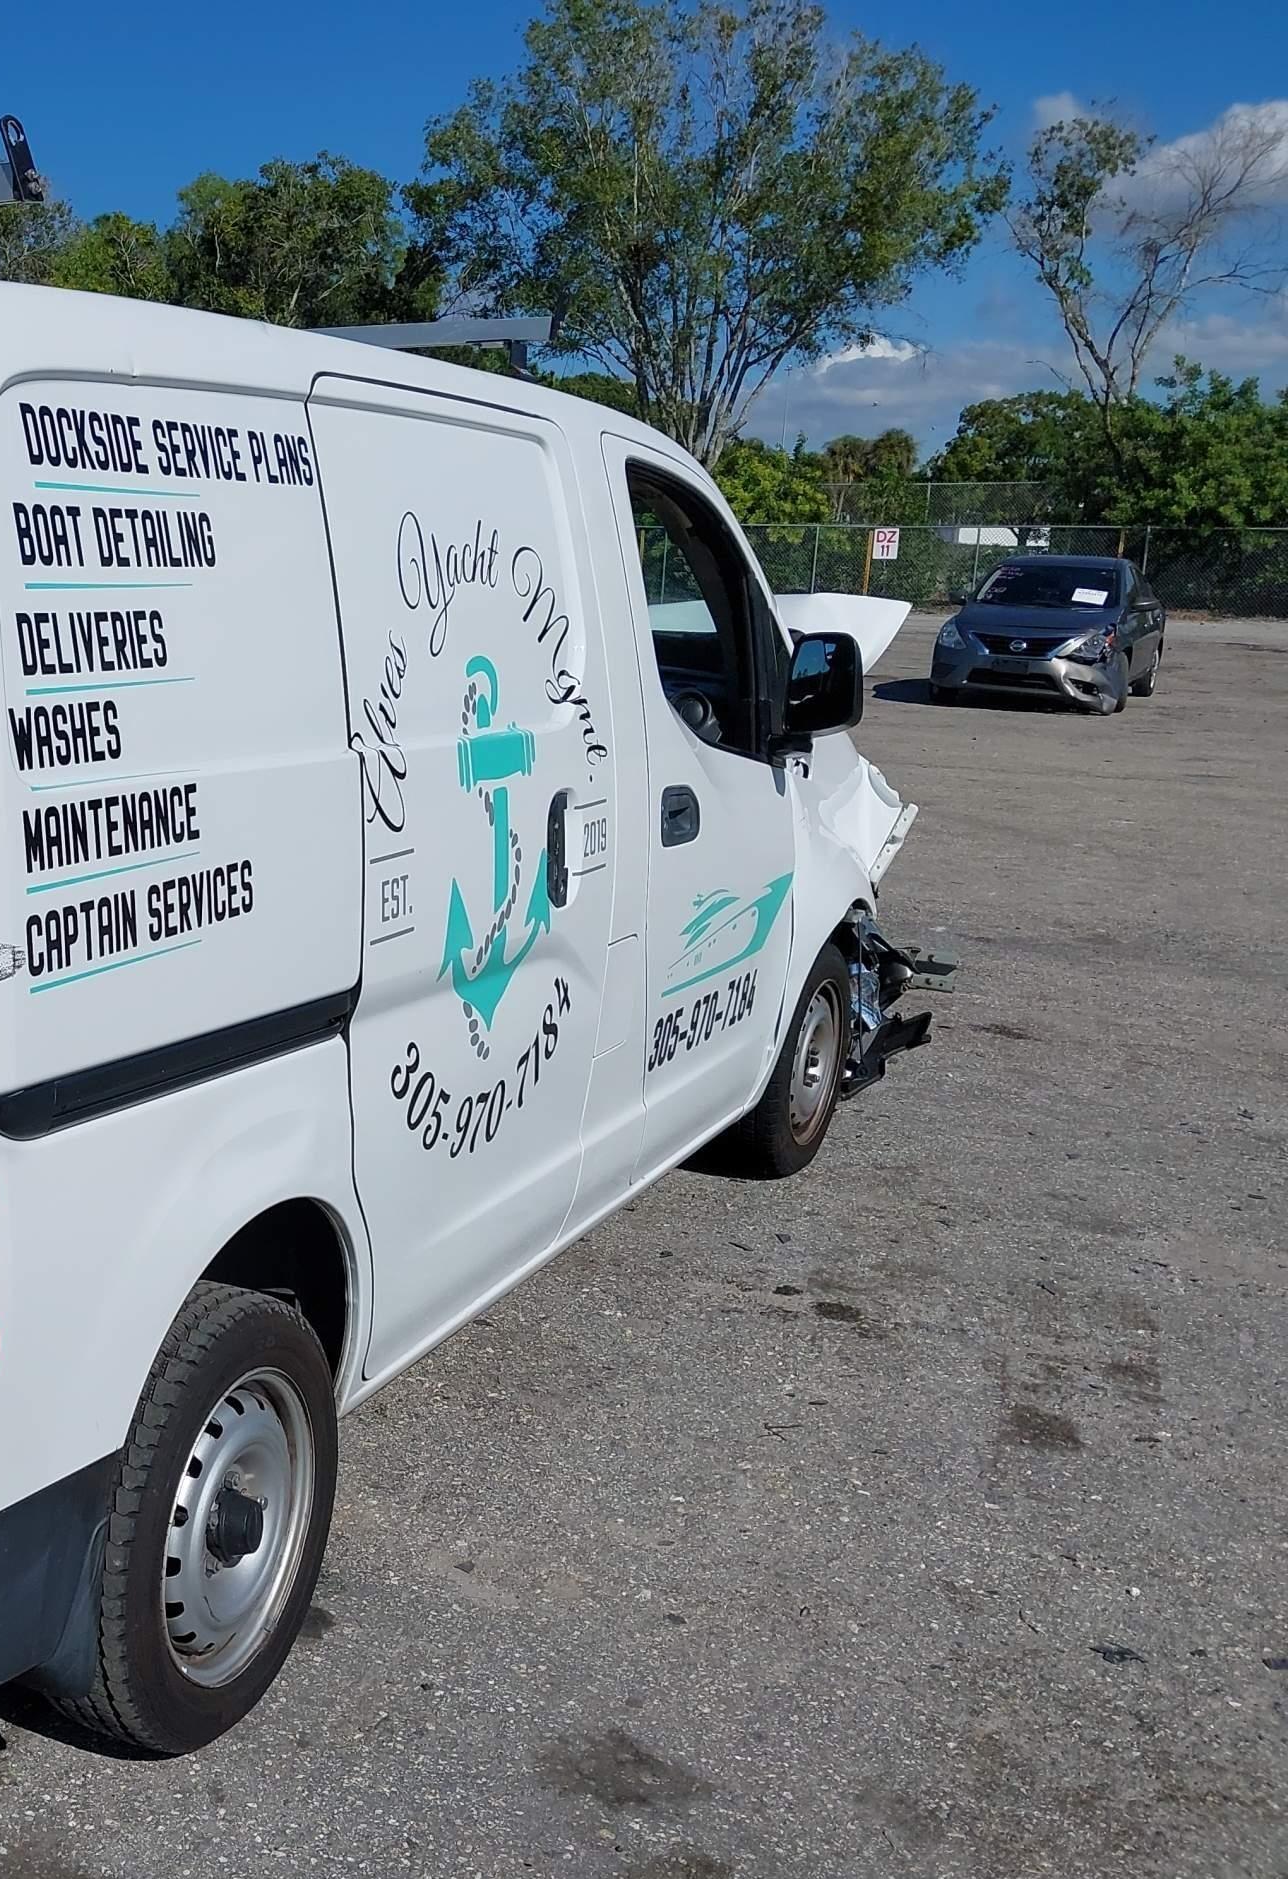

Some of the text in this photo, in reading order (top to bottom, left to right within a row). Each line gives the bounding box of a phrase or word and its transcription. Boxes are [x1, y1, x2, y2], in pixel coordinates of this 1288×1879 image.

[18, 401, 313, 487] DOCKSIDE SERVICE PLANS
[12, 501, 216, 568] BOAT DETAILING
[876, 530, 897, 543] DZ
[881, 544, 890, 557] 11
[396, 511, 500, 658] Yacht
[15, 610, 168, 676] DELIVERIES
[8, 699, 122, 772] WASHES
[22, 783, 201, 874] MAINTENANCE
[583, 817, 607, 857] 2019
[25, 859, 254, 977] CAPTAIN SERVICES
[381, 874, 413, 923] EST.
[647, 968, 759, 1073] 305-970-7184
